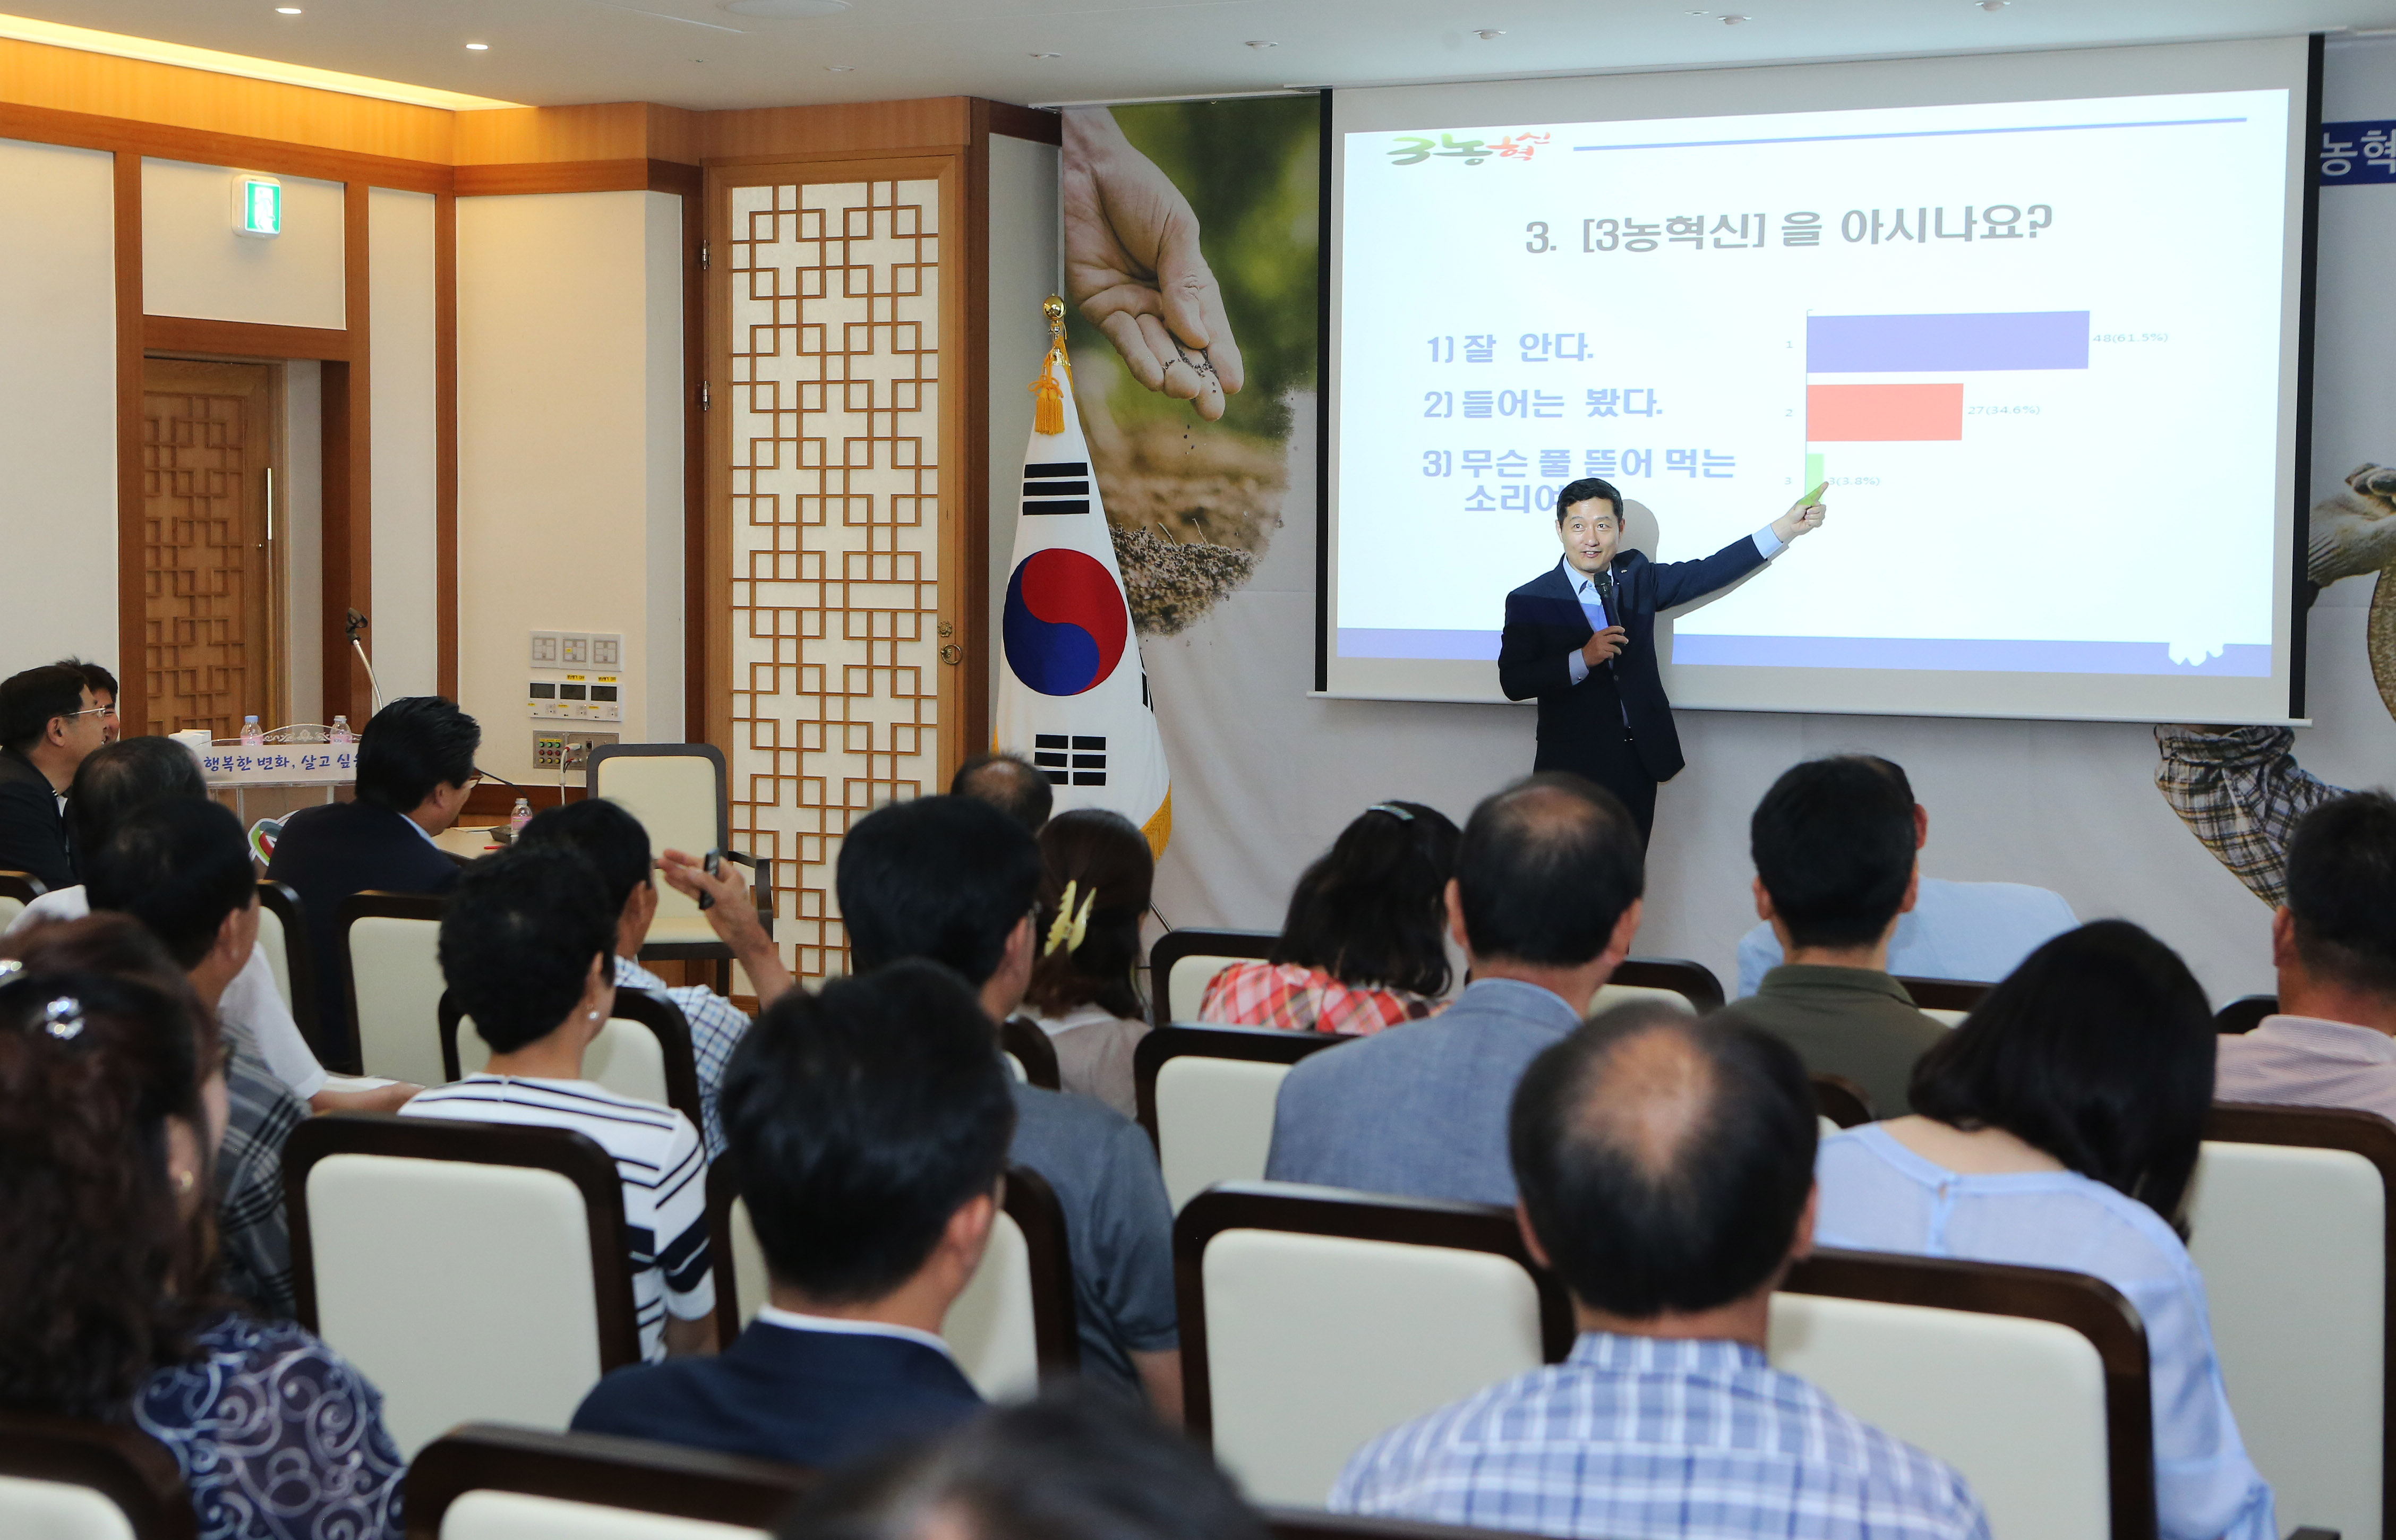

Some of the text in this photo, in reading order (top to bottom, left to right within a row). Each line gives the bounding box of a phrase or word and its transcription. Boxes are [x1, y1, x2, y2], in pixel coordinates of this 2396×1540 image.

[1526, 203, 2052, 254] 3. [3농혁신] 을 아시나요?
[1786, 340, 1793, 349] 1
[2092, 333, 2169, 344] 48(61.5%)
[1463, 334, 1497, 363] 잘
[1519, 332, 1594, 362] 안다.
[1462, 389, 1565, 418] 들어는
[1585, 388, 1663, 418] 봤다.
[1785, 408, 1793, 417] 2
[1967, 406, 2041, 416] 27(34.6%)
[1461, 449, 1528, 478] 무슨
[1539, 449, 1571, 477] 풀
[1584, 449, 1652, 478] 뜯어
[1665, 448, 1736, 478] 먹는
[1784, 477, 1792, 485] 3
[203, 756, 252, 772] 행복한
[257, 755, 296, 770] 변화,
[301, 754, 330, 770] 살고
